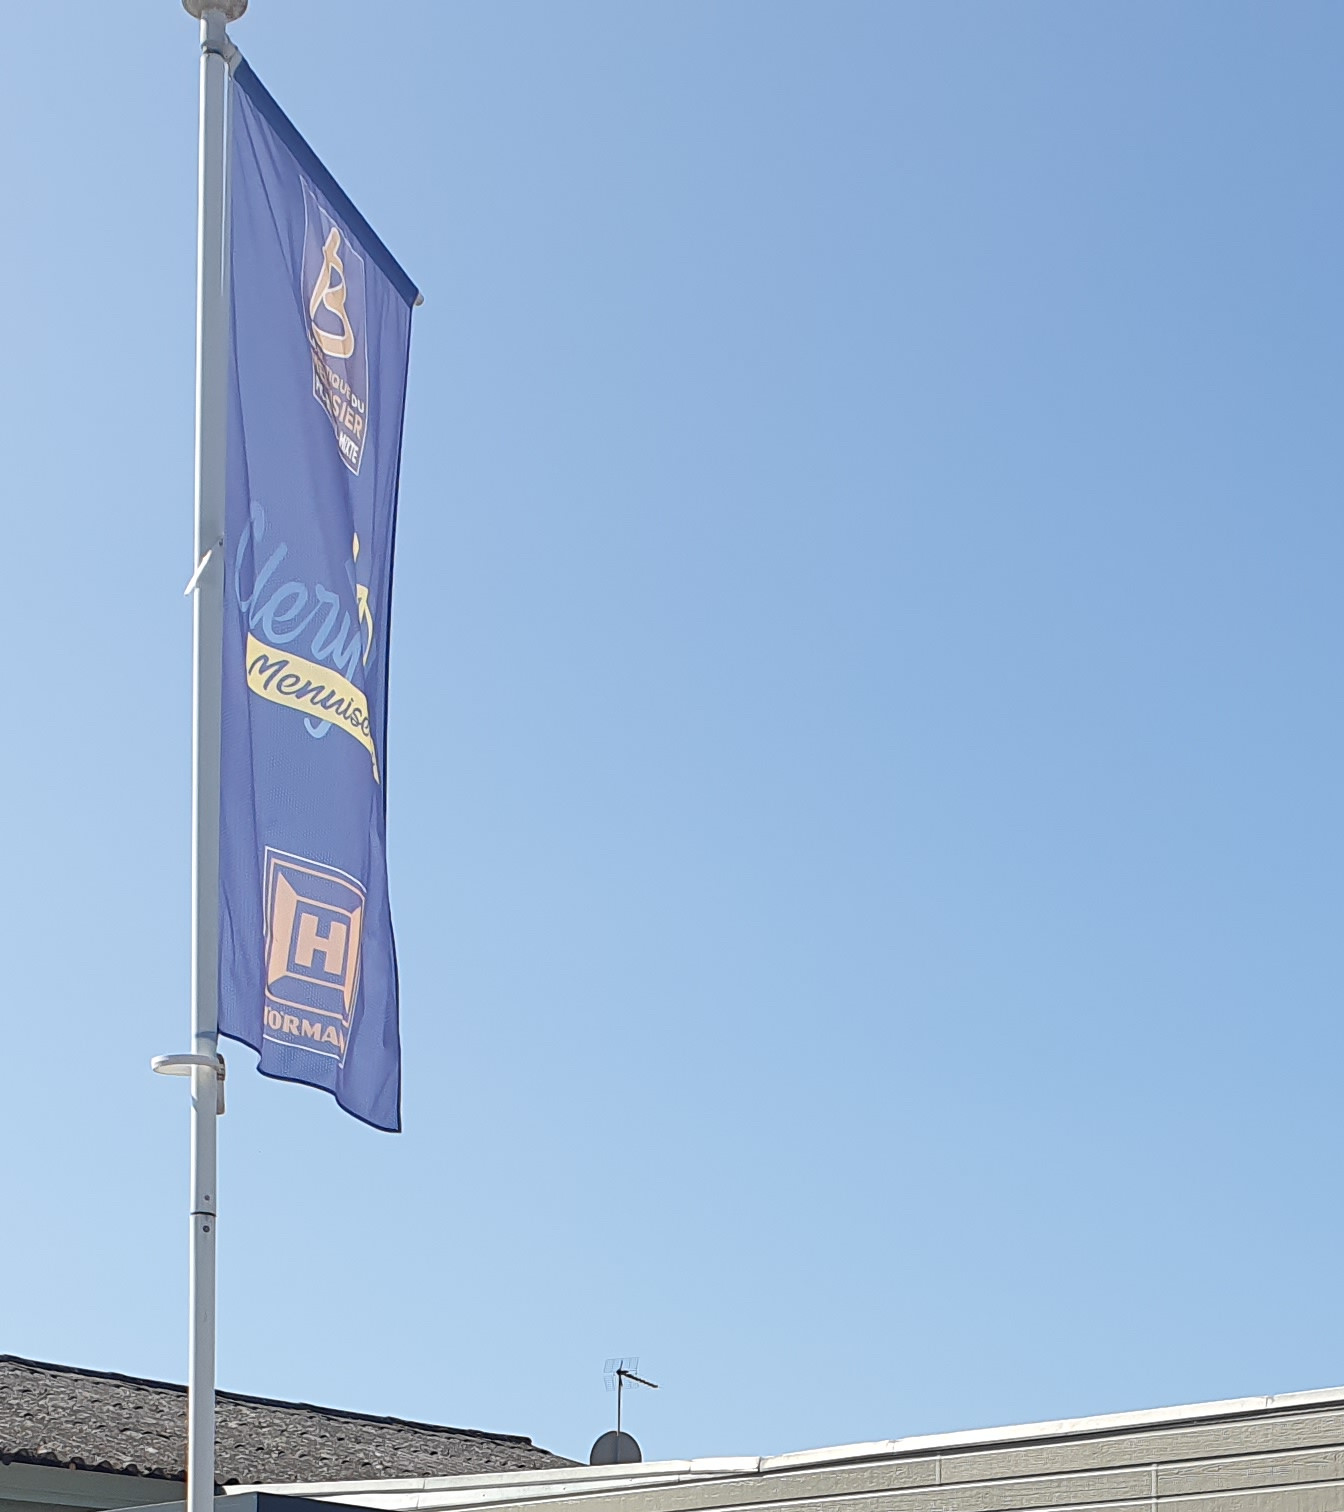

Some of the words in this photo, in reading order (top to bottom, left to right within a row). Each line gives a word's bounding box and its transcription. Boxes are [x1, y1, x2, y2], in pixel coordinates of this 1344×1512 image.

[351, 396, 364, 413] DU
[339, 431, 359, 463] MIXTE
[295, 913, 346, 975] H
